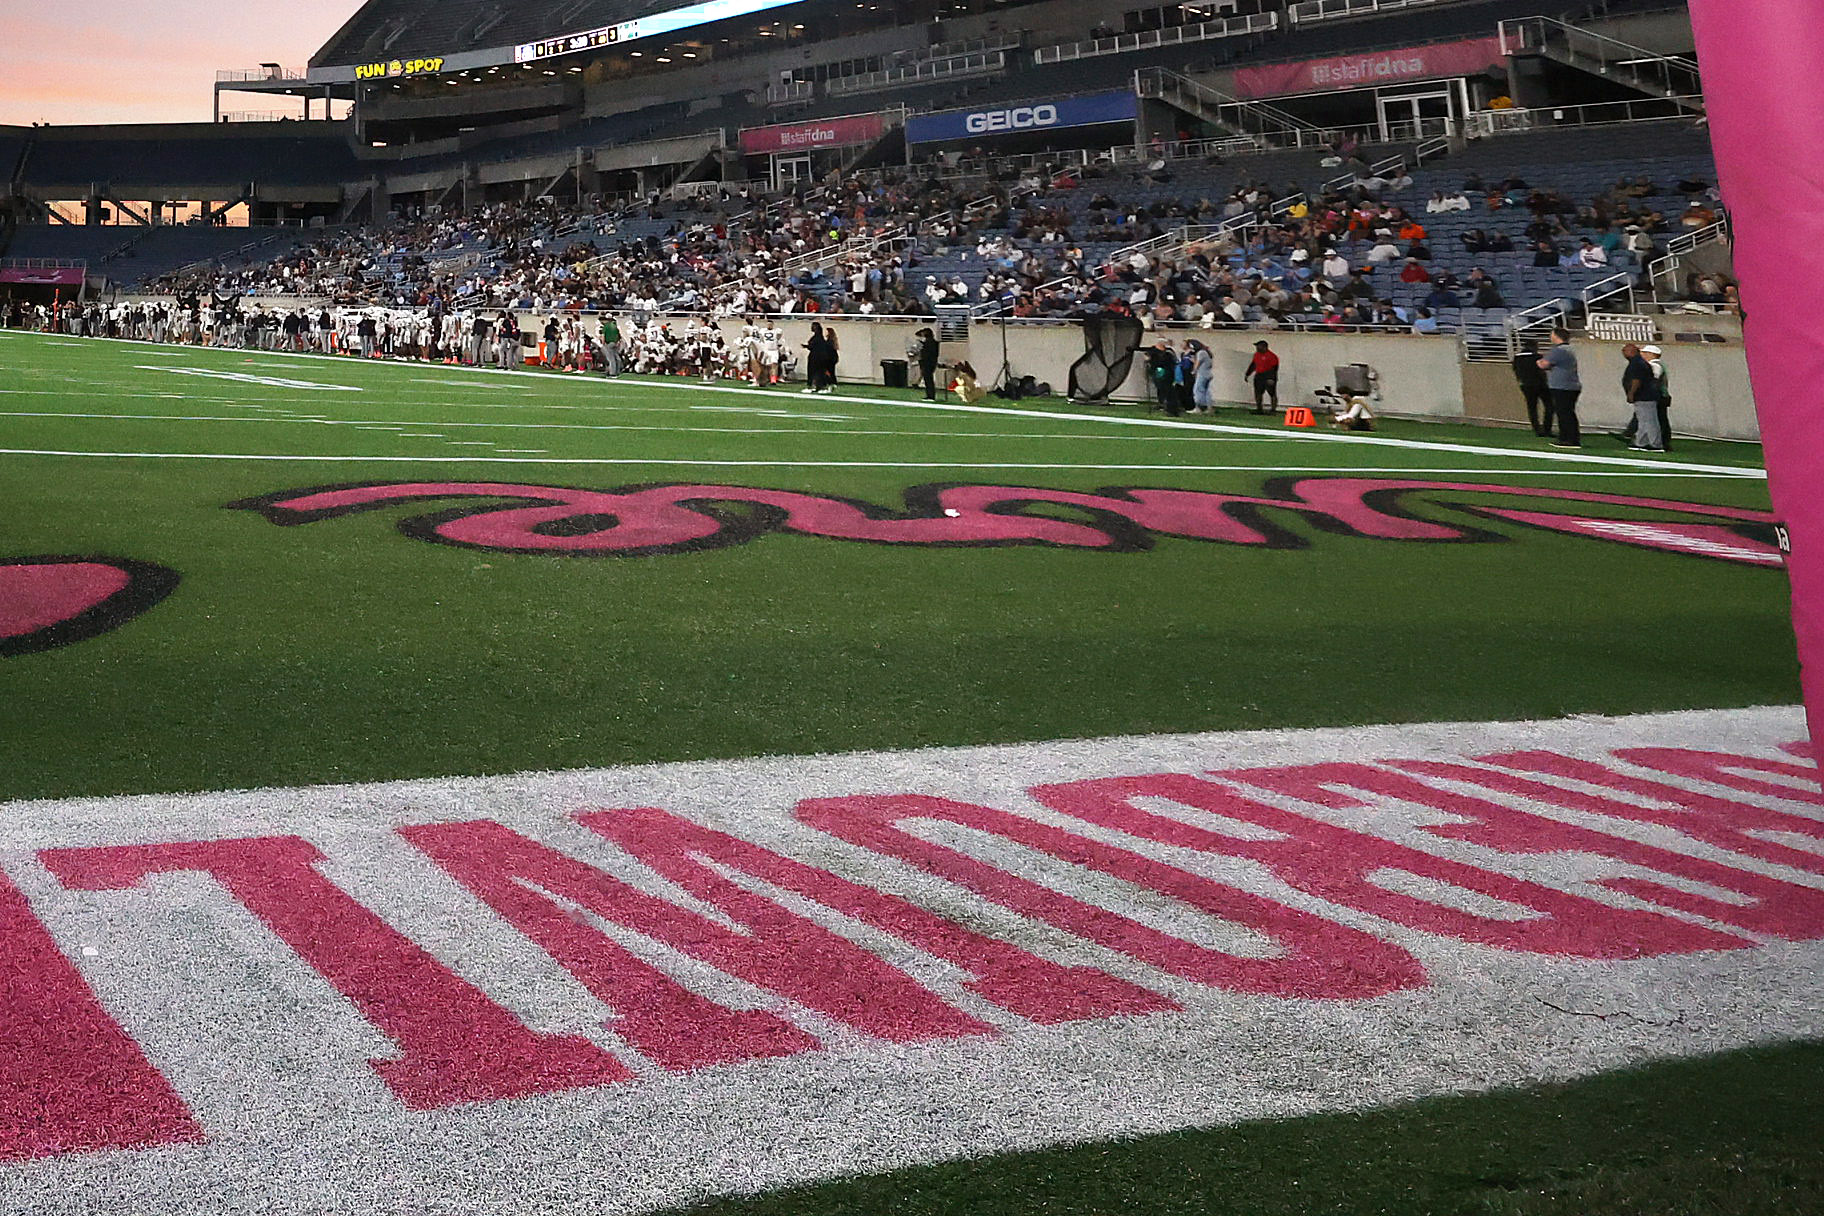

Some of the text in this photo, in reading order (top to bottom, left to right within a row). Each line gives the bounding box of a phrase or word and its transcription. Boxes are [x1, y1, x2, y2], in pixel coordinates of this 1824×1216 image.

[355, 58, 444, 80] FUN SPOT
[1330, 56, 1424, 81] staffdna
[966, 104, 1057, 133] GEICO
[1290, 409, 1305, 424] 10
